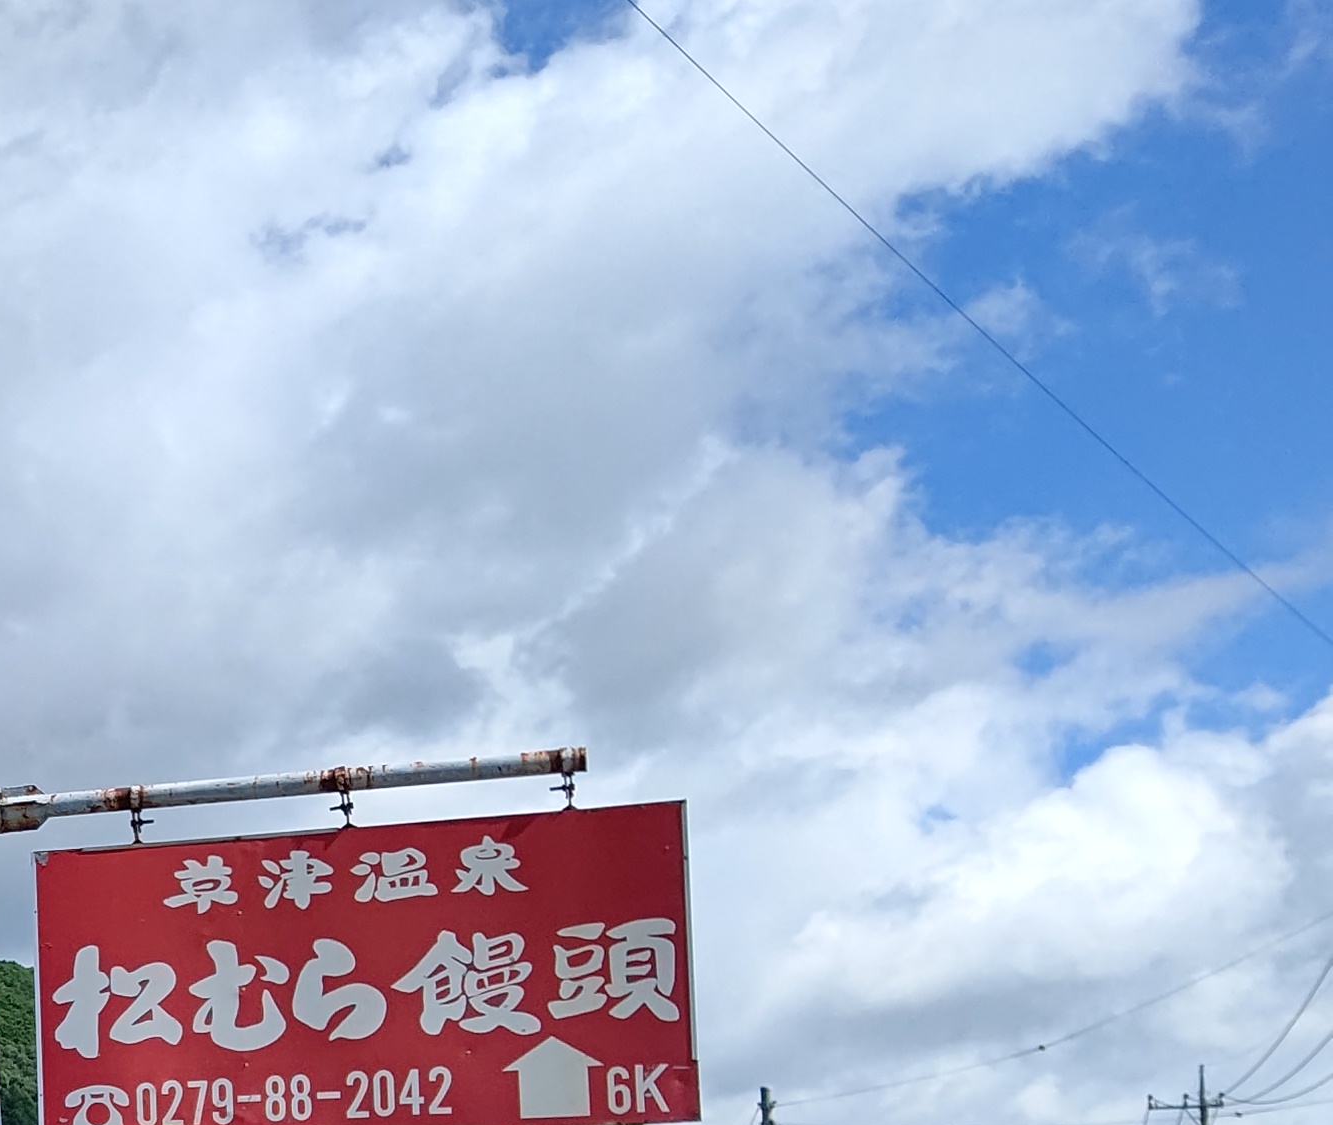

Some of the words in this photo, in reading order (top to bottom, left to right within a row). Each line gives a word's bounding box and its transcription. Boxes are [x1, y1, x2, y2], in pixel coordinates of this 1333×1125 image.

[163, 836, 529, 914] 草津温泉
[53, 918, 680, 1058] 松むら饅頭
[607, 1063, 670, 1115] 6K
